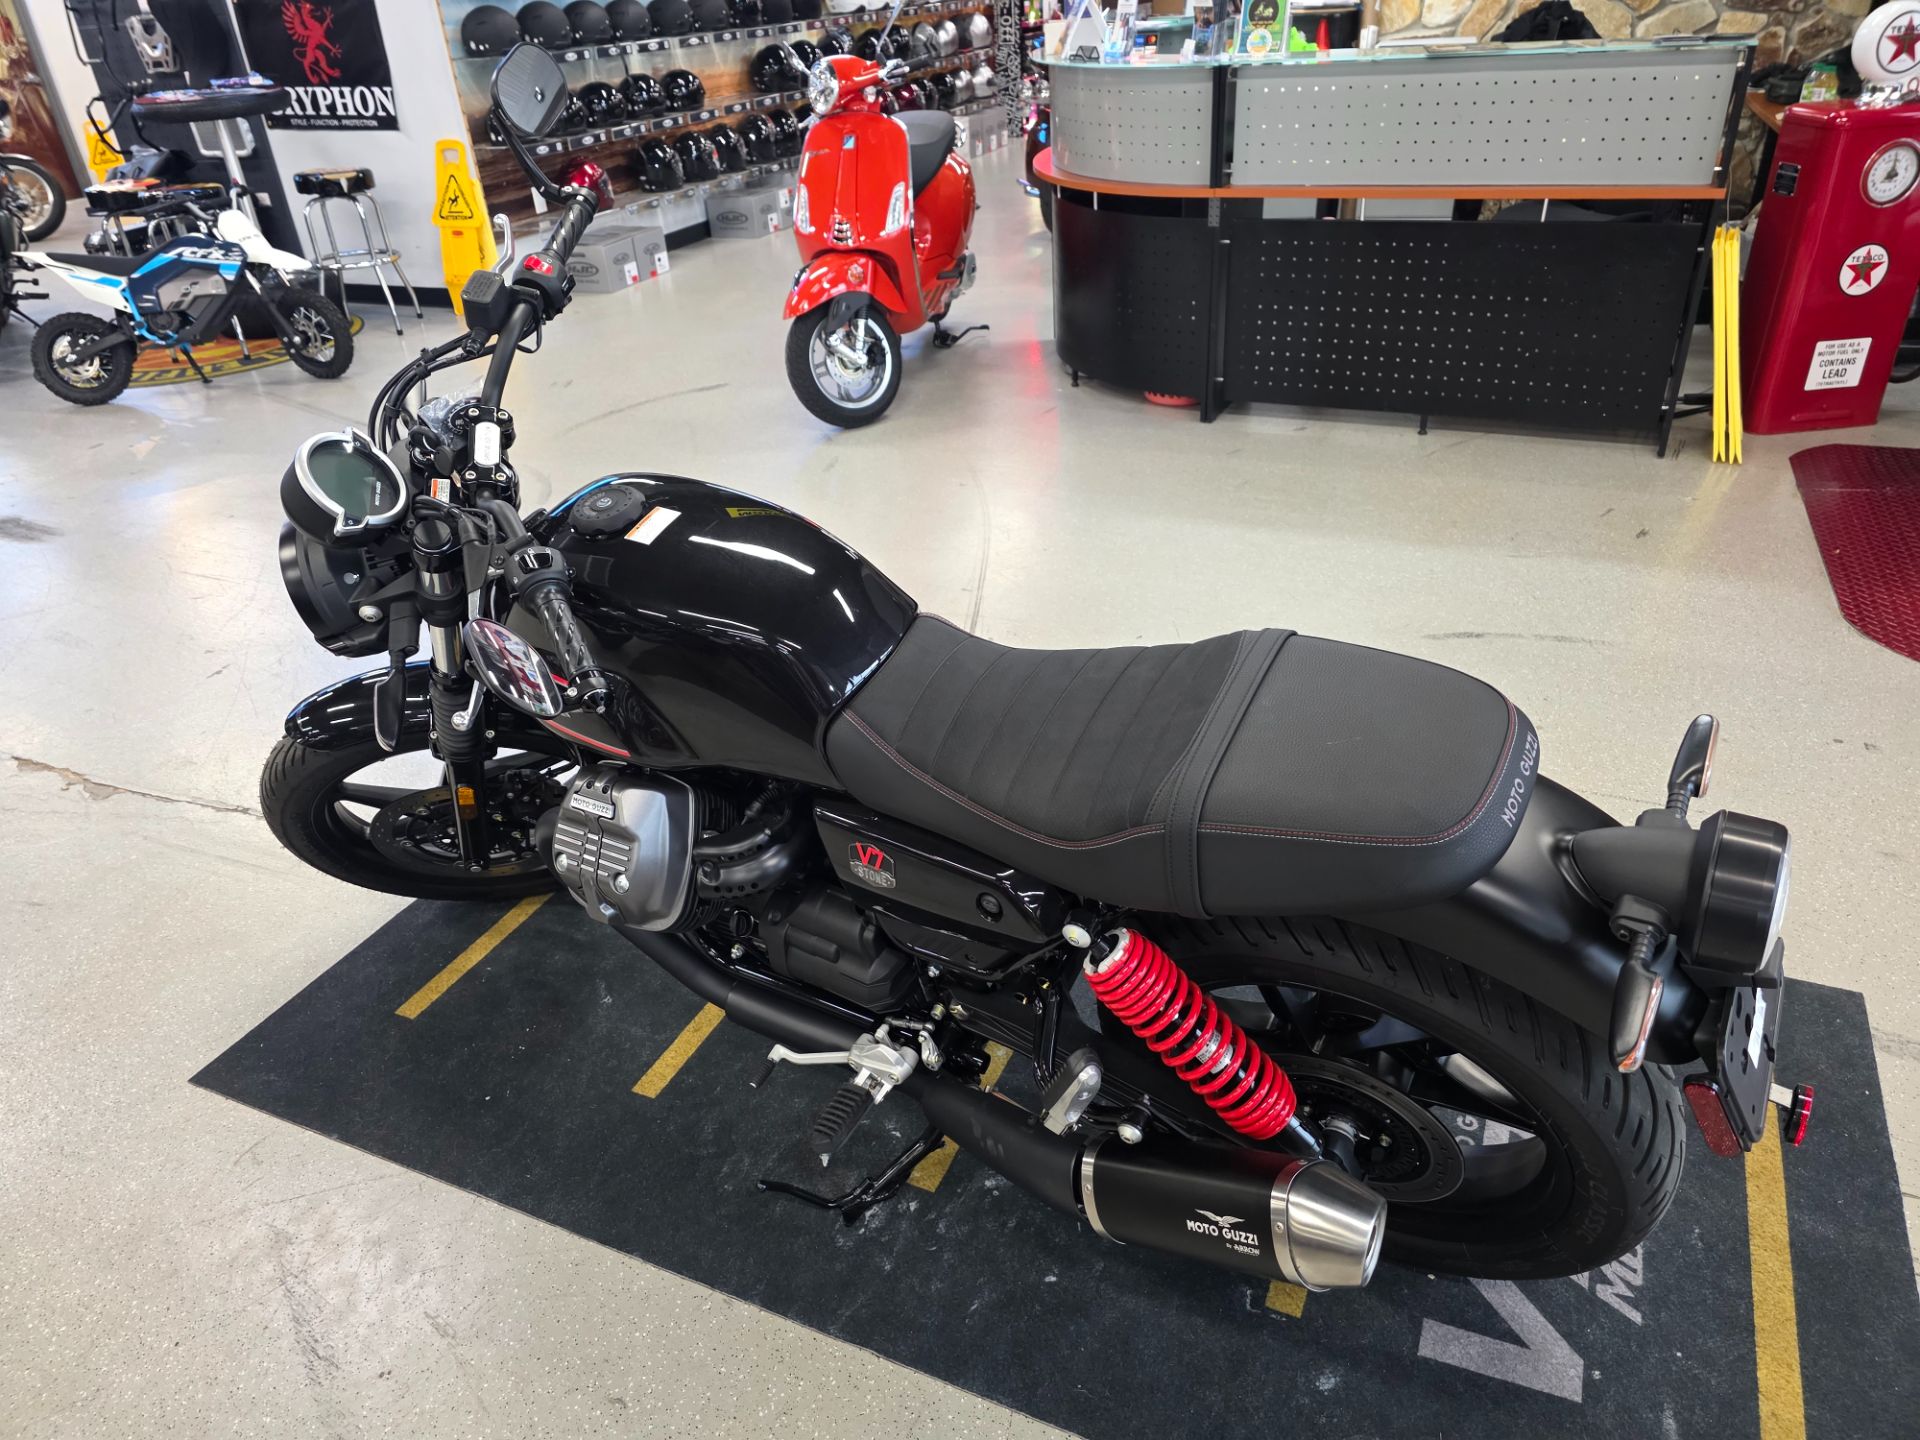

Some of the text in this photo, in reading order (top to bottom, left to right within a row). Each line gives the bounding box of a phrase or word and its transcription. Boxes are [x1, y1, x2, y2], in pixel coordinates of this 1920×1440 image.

[272, 86, 396, 117] RYPHON
[290, 118, 378, 127] STYLE FUNCTION PROTECTION
[1851, 253, 1884, 263] TEXACO
[1819, 357, 1857, 368] CONTAINS
[1822, 368, 1847, 379] LEAD
[1501, 730, 1538, 828] MOTO GUZZI
[572, 796, 590, 808] MOTO
[855, 841, 884, 872] V7
[858, 866, 888, 887] STONE
[1186, 1219, 1259, 1246] MOTO GUZZI
[1233, 1243, 1260, 1255] ARROW
